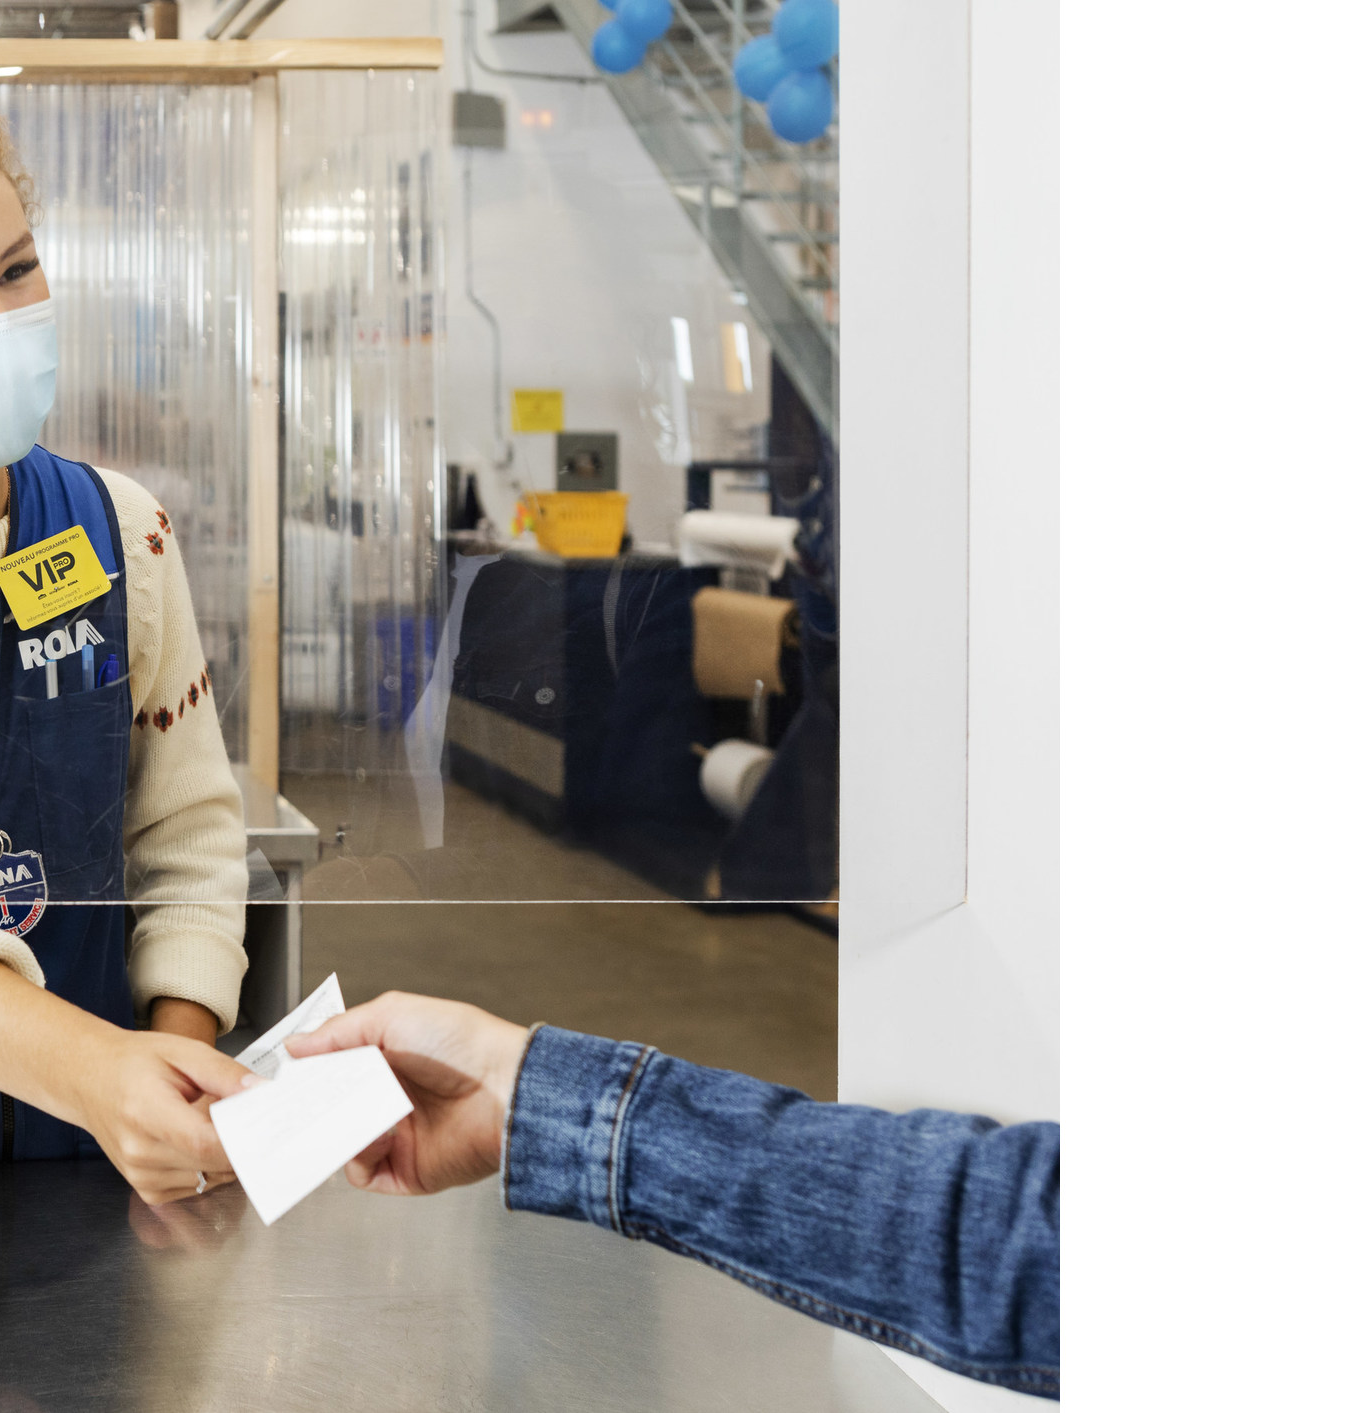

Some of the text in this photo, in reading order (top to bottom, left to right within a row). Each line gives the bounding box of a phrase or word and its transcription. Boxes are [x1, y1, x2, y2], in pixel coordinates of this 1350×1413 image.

[0, 532, 80, 572] NOUVEAU PROGRAMME PRO
[17, 551, 76, 592] VIP
[53, 557, 70, 569] PRO
